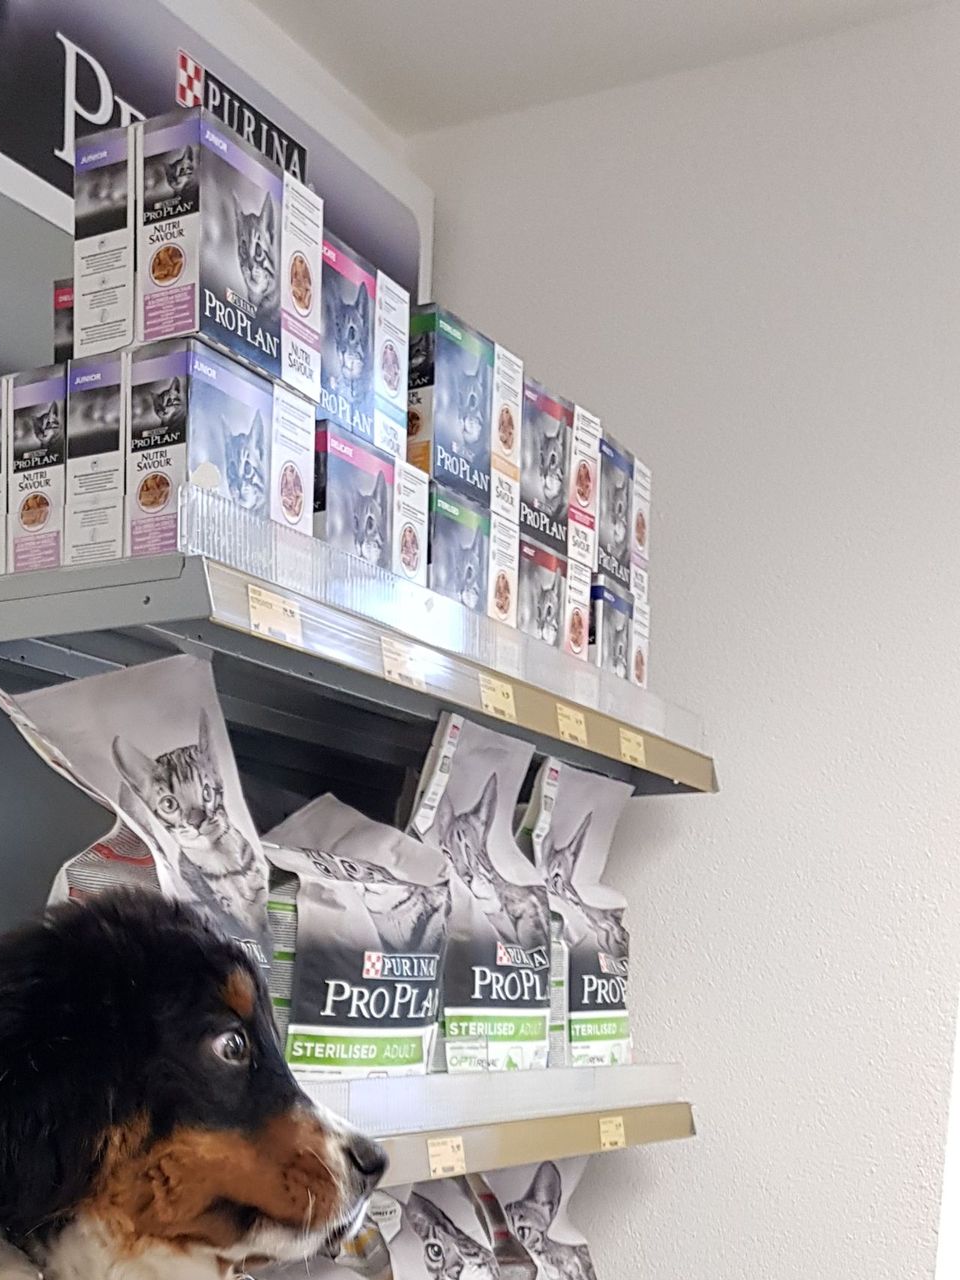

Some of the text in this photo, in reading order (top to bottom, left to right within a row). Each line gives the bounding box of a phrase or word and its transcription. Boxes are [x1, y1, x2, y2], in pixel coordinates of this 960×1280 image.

[153, 220, 180, 235] NUTRI
[148, 229, 185, 245] SAVOUR
[141, 449, 168, 462] NUTRI
[136, 458, 173, 473] SAVOUR
[22, 470, 48, 482] NUTRI
[18, 478, 51, 492] SAVOUR
[449, 1022, 516, 1037] STERILISED
[291, 1041, 417, 1060] STERILISED ADULT
